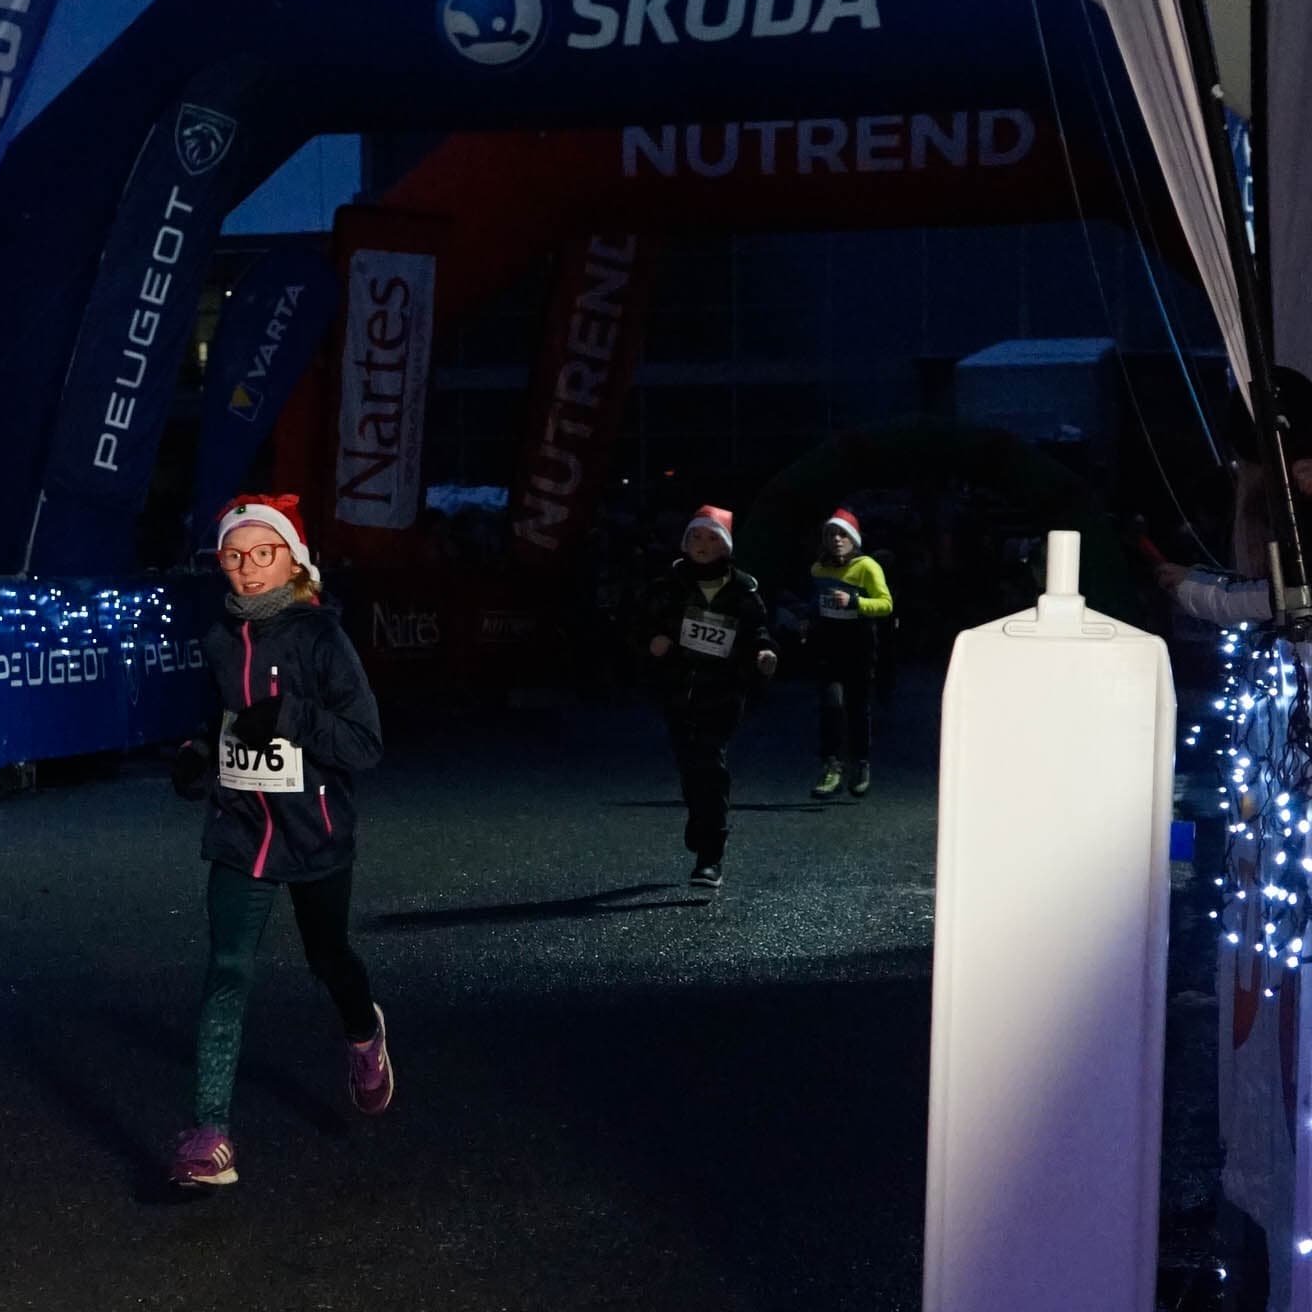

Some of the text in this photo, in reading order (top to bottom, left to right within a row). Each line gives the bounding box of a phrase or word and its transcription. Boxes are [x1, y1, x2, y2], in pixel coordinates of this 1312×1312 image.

[621, 107, 1036, 179] NUTREND
[92, 185, 195, 472] PEUGEOT
[248, 282, 308, 384] VARTA
[340, 275, 411, 503] Nartes
[144, 637, 208, 679] PEUG
[688, 623, 727, 645] 3122
[224, 740, 285, 772] 3076
